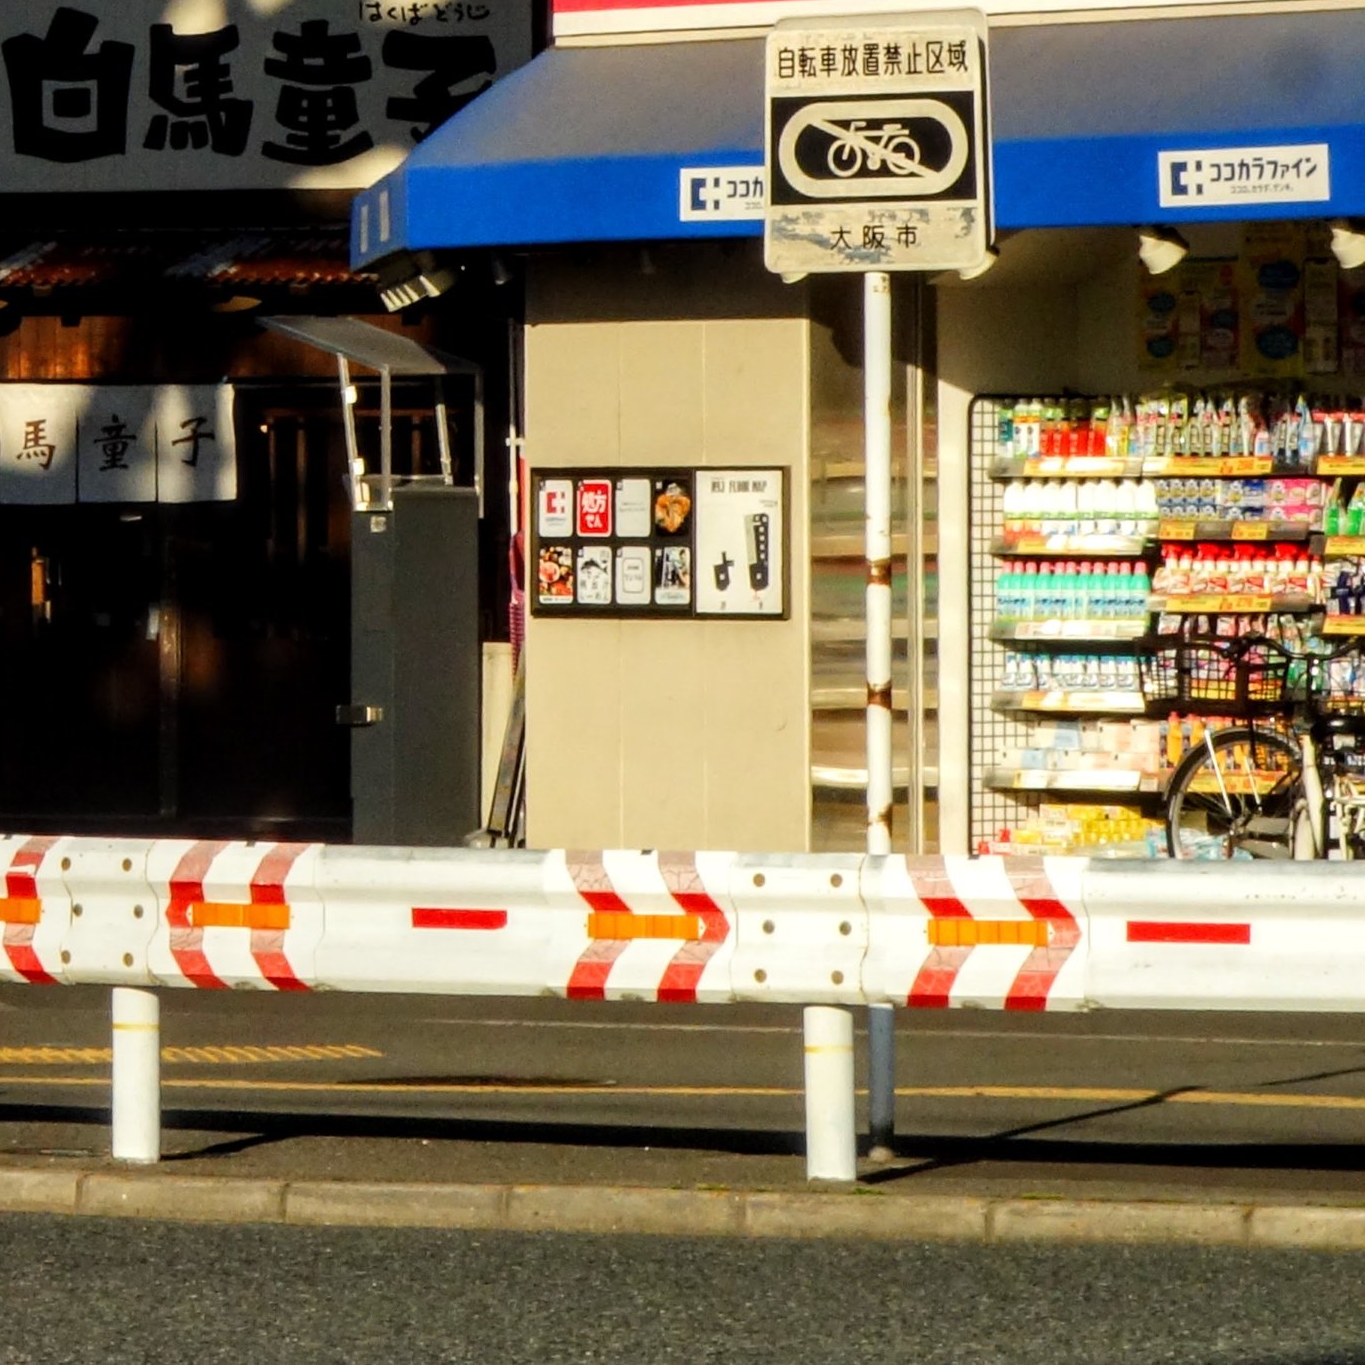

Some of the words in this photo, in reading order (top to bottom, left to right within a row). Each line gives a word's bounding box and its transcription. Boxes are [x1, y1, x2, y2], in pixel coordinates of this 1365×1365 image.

[359, 1, 490, 25] はくばどうじ
[778, 41, 969, 79] 自転車放置禁止区域
[0, 7, 497, 166] 白馬童子
[1210, 157, 1317, 182] ココカラファイン
[727, 176, 763, 198] ココカ
[830, 224, 917, 251] 大阪市
[581, 490, 607, 514] 処方
[584, 515, 603, 529] せん
